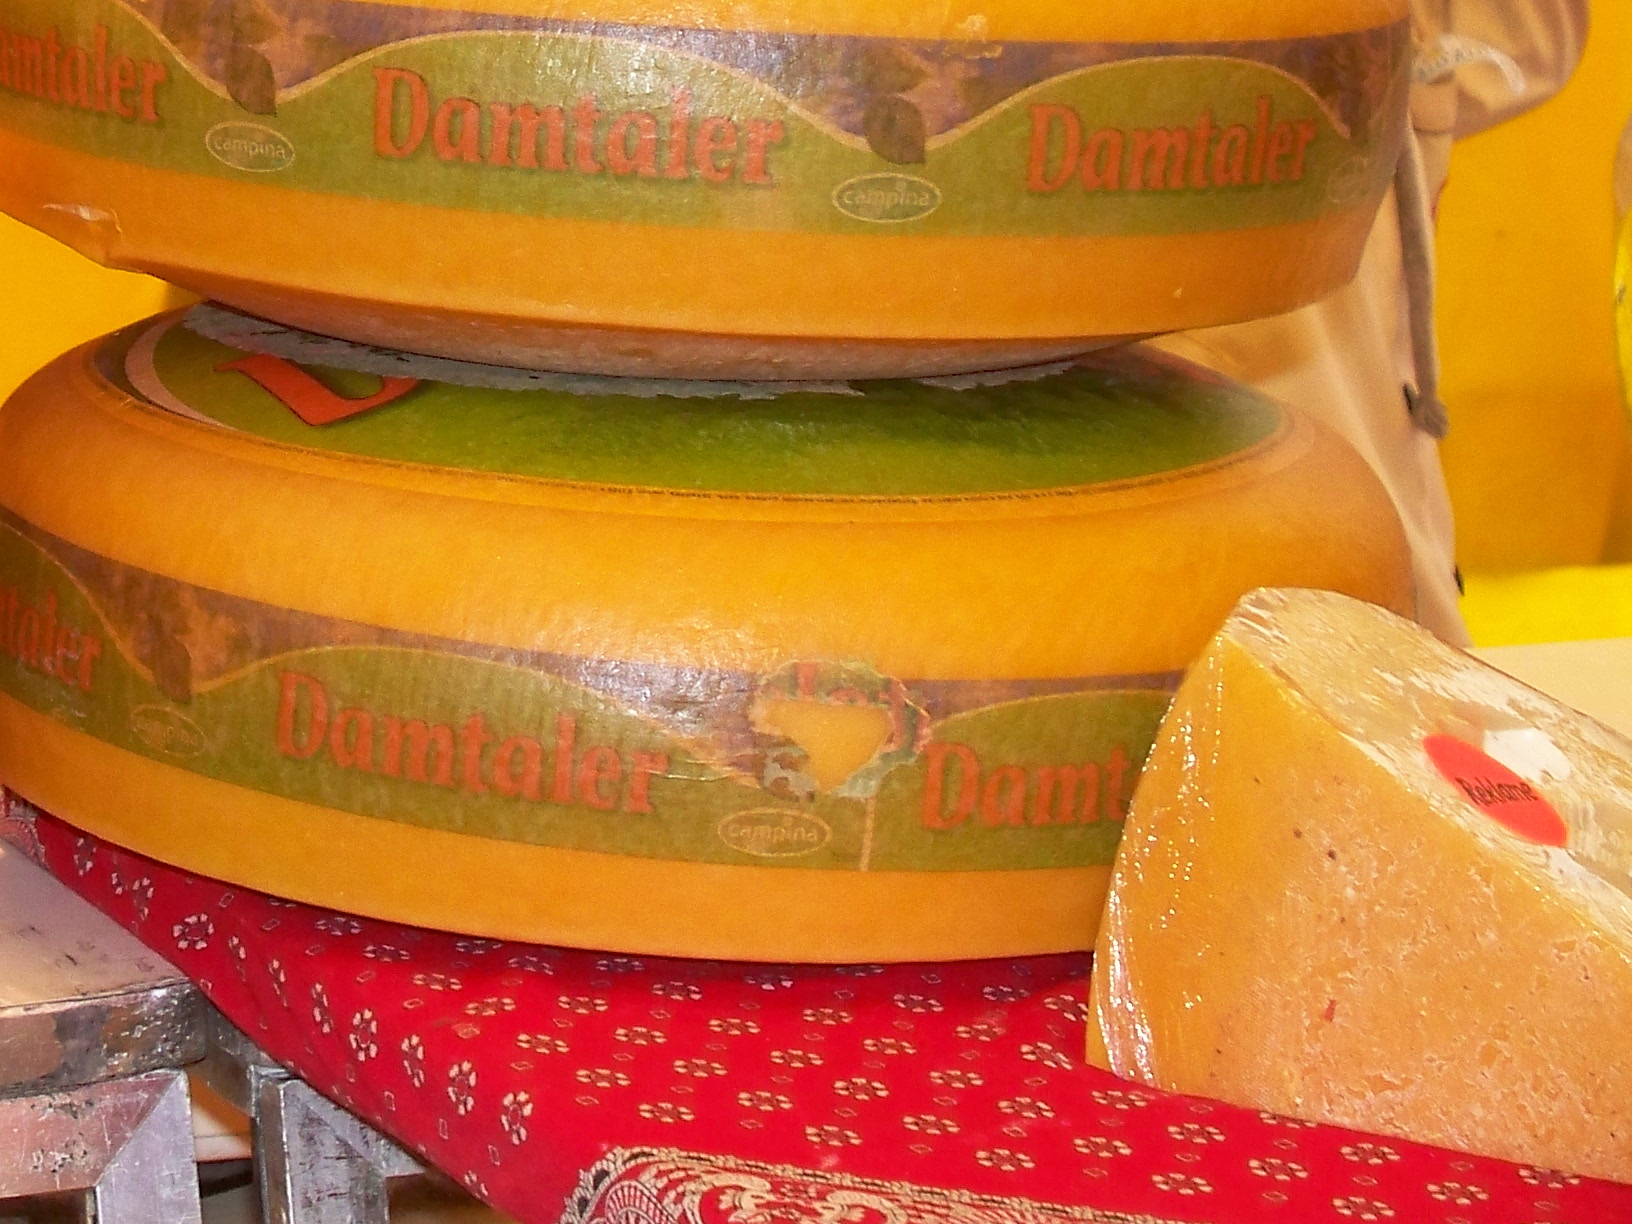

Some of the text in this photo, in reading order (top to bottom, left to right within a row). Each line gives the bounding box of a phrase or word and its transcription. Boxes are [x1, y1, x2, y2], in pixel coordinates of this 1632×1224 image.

[371, 65, 786, 187] Damtaler
[1023, 96, 1318, 196] Damtaler
[841, 180, 931, 212] campina
[275, 667, 671, 816] Damtaler
[919, 739, 1141, 833] Damt
